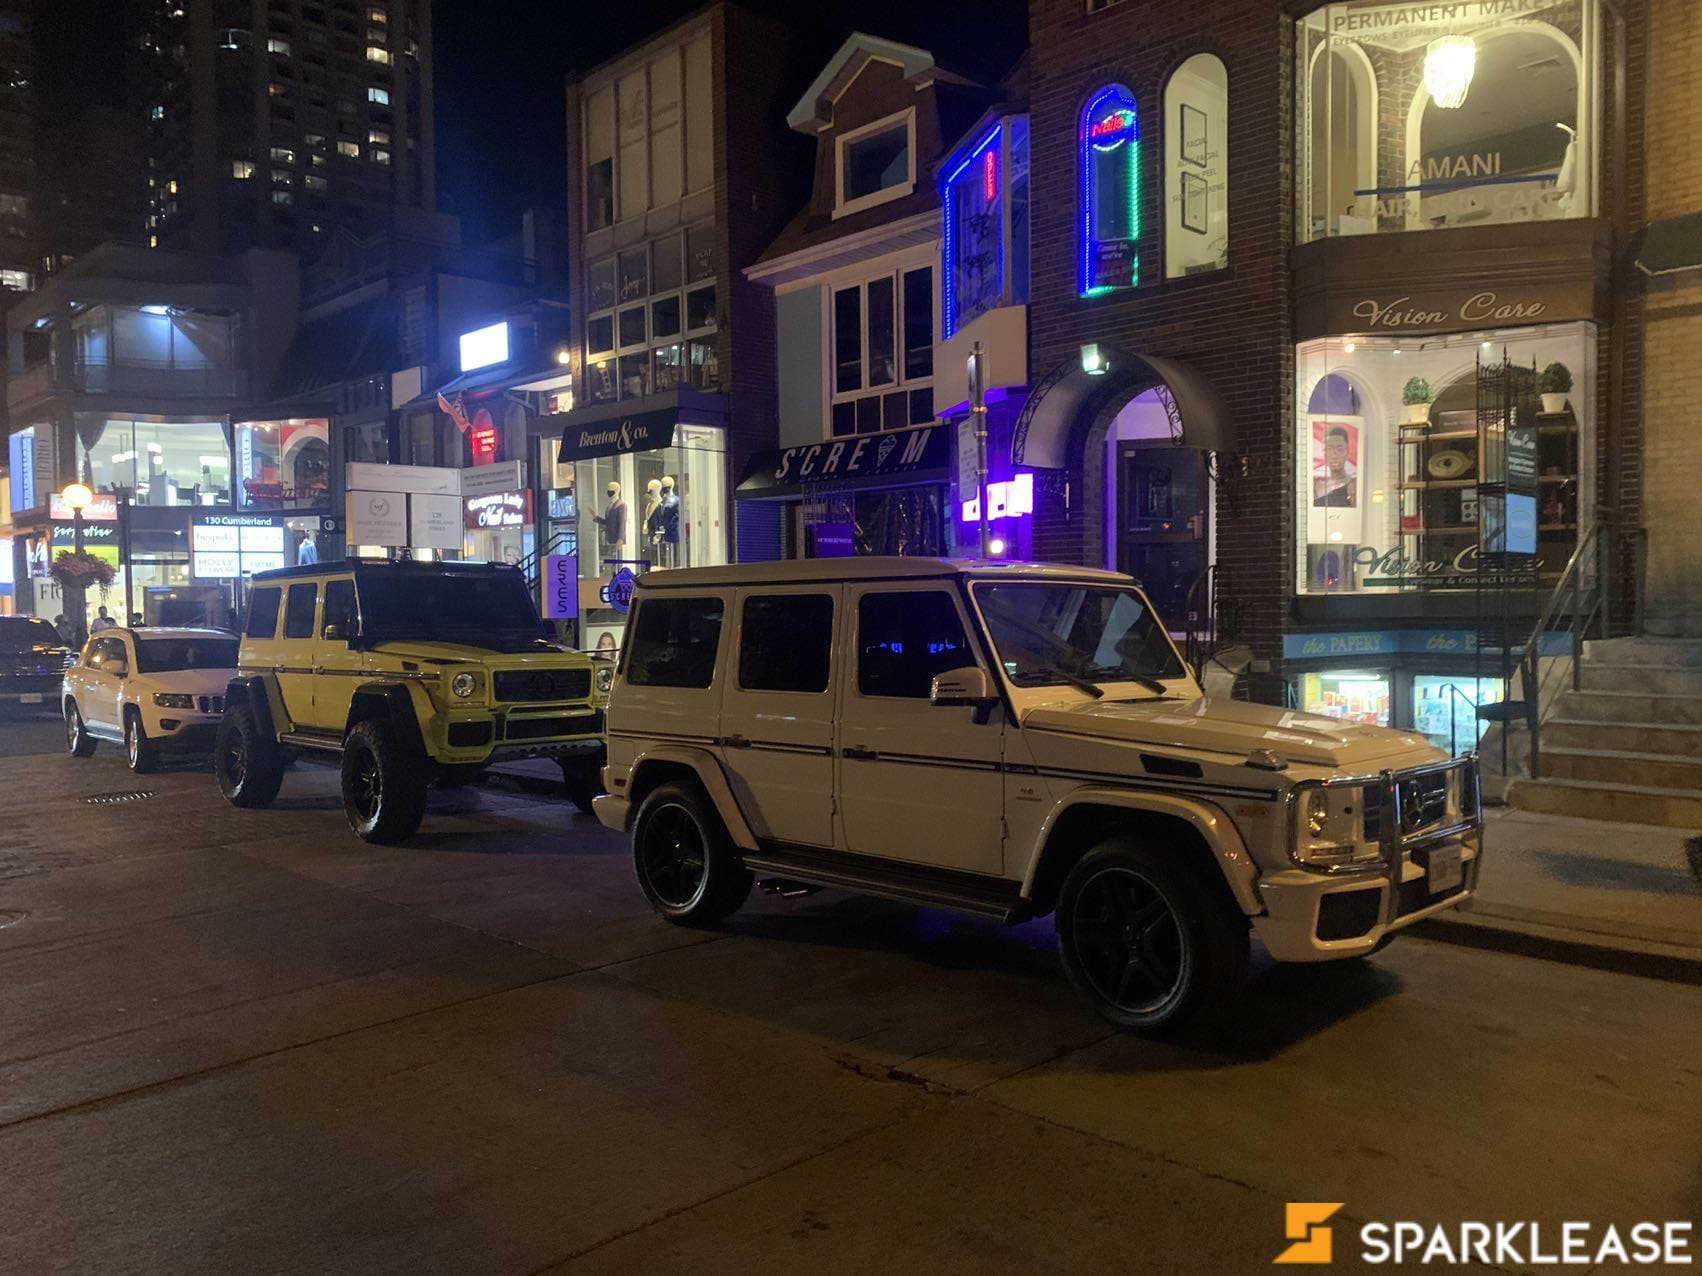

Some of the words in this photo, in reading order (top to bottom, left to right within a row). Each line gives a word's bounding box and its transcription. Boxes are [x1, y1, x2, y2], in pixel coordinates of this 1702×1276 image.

[1333, 3, 1467, 32] PERMANENT
[1407, 152, 1501, 181] AMANI
[1353, 297, 1448, 328] Vision
[1459, 292, 1546, 322] Care
[578, 430, 618, 448] Brenton
[205, 517, 219, 525] 130
[221, 516, 272, 526] Cumberland
[557, 559, 568, 614] ERES
[1425, 633, 1458, 650] the
